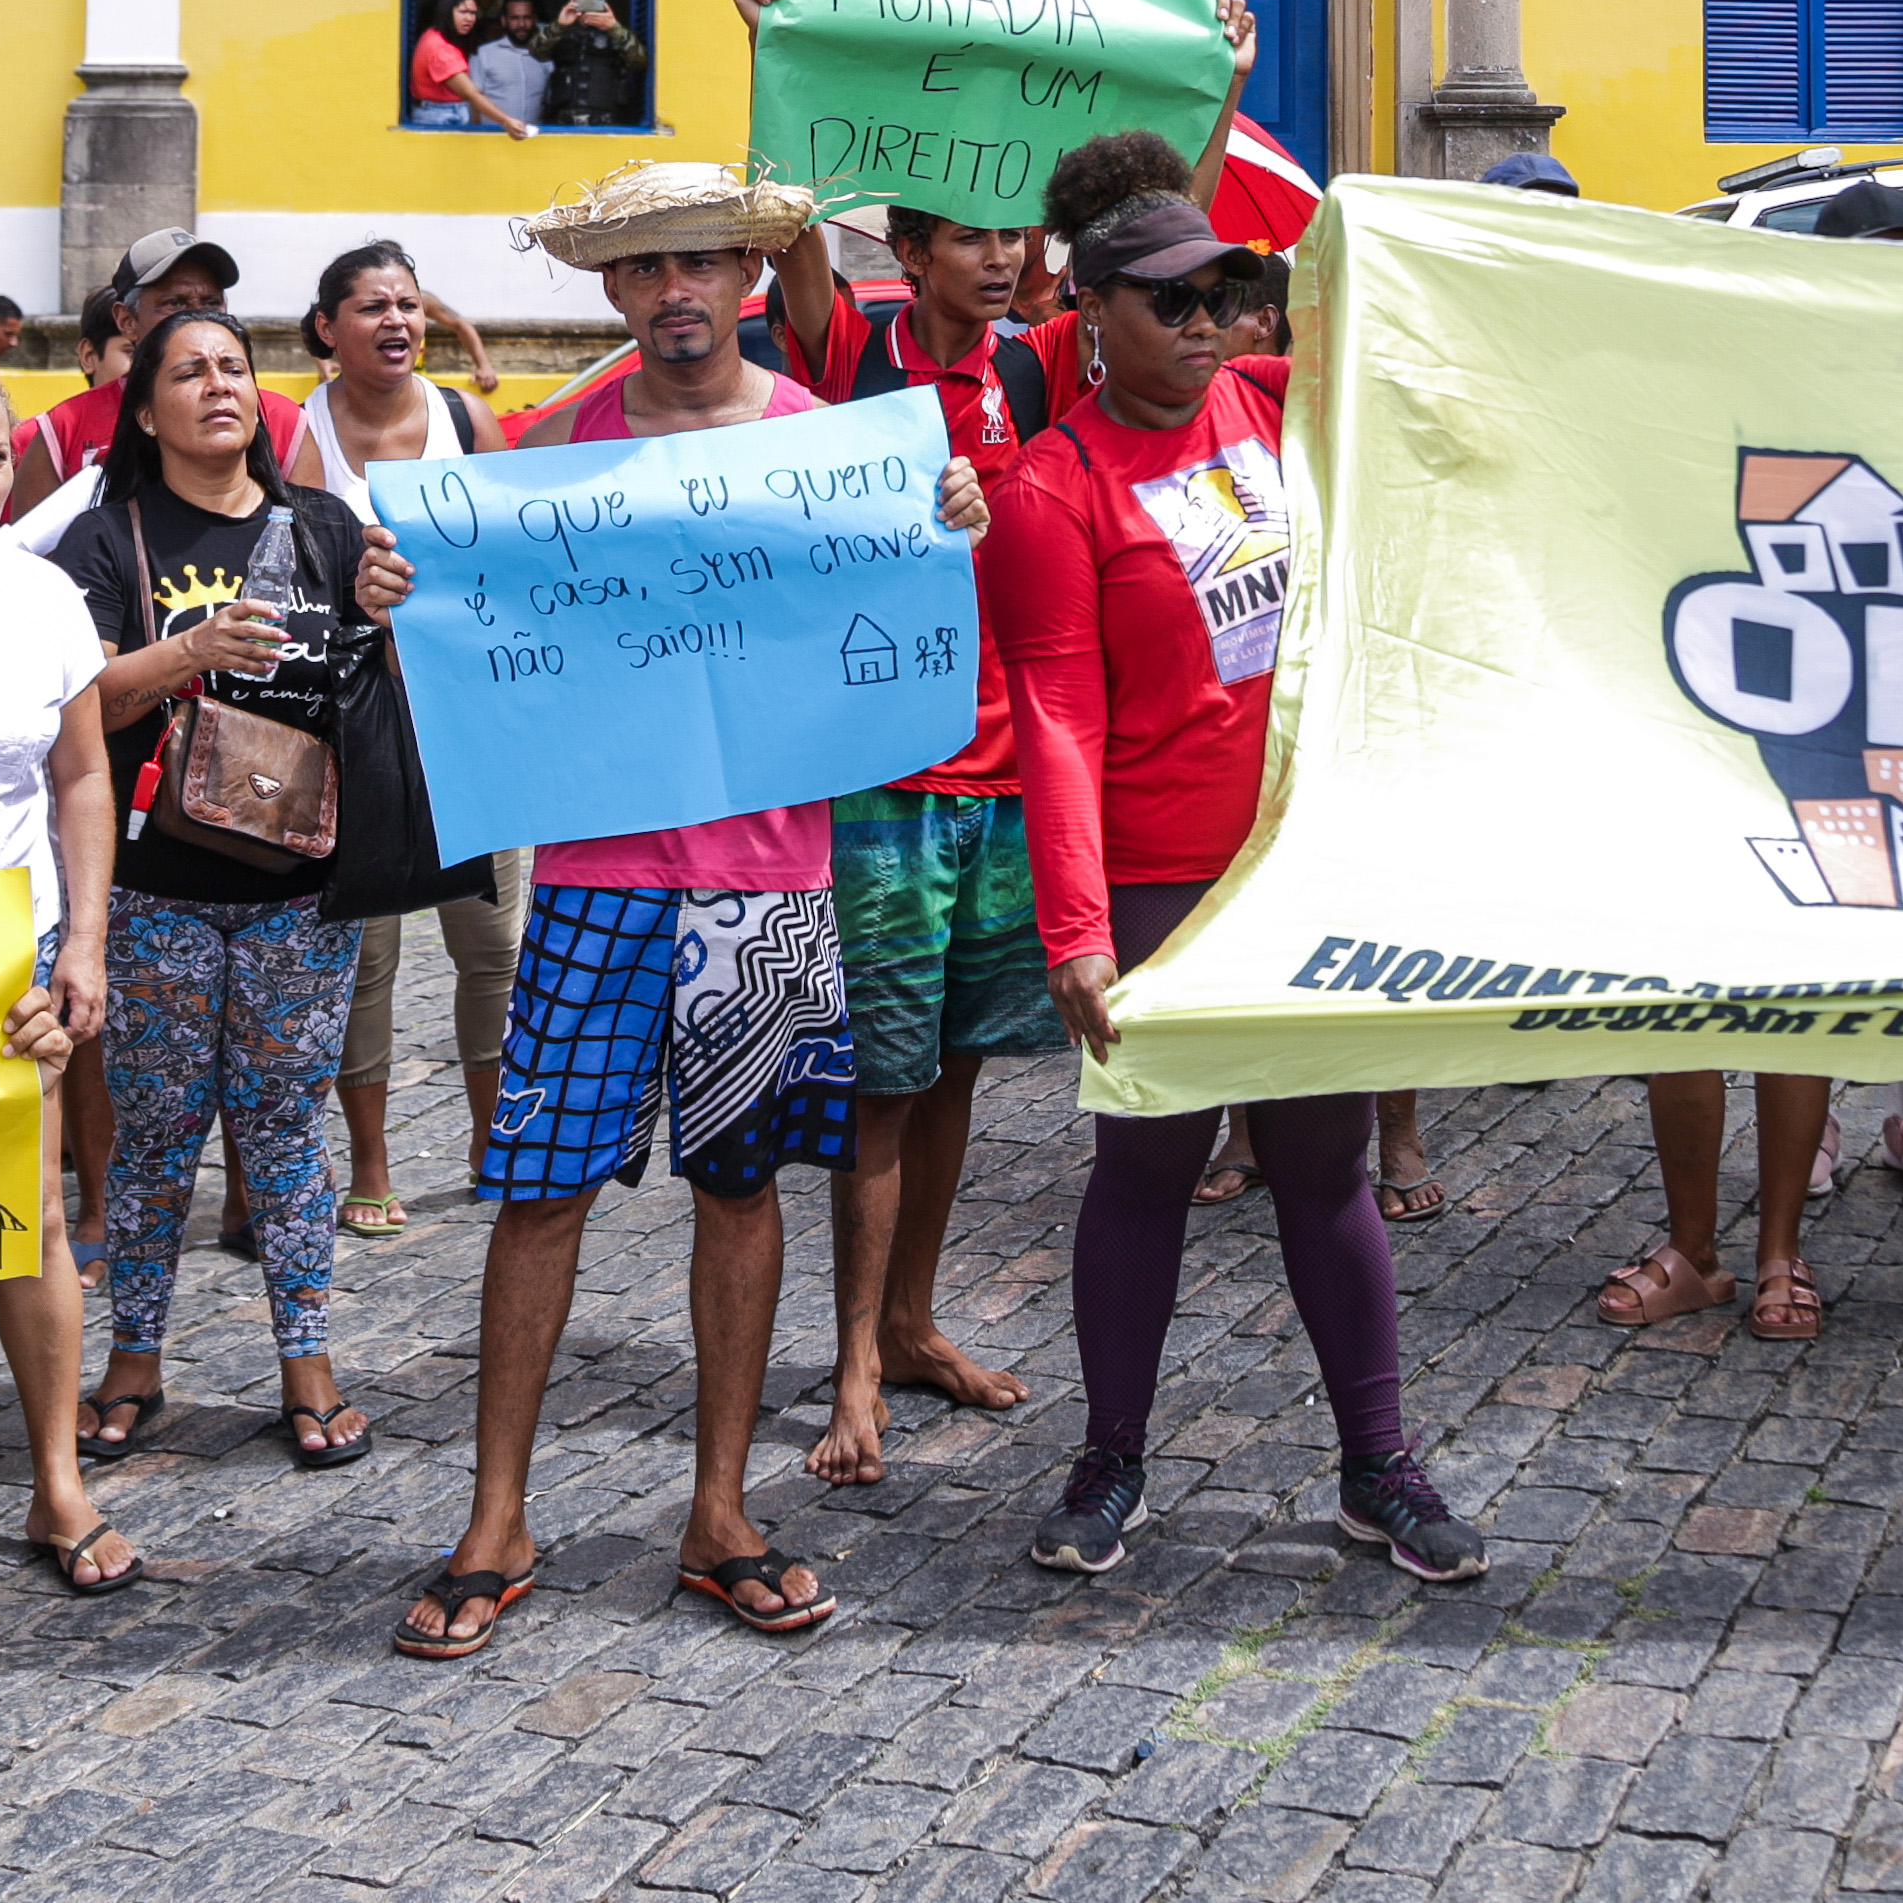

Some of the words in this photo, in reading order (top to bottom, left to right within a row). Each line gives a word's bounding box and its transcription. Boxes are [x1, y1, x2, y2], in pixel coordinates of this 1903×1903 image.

[922, 41, 975, 92] É
[1020, 61, 1103, 114] UM
[420, 471, 479, 549] O
[518, 489, 632, 572] que
[680, 475, 729, 517] eu
[765, 455, 908, 521] quero
[464, 573, 495, 627] é
[529, 574, 648, 615] casa,
[809, 521, 930, 575] chave
[487, 631, 565, 683] não
